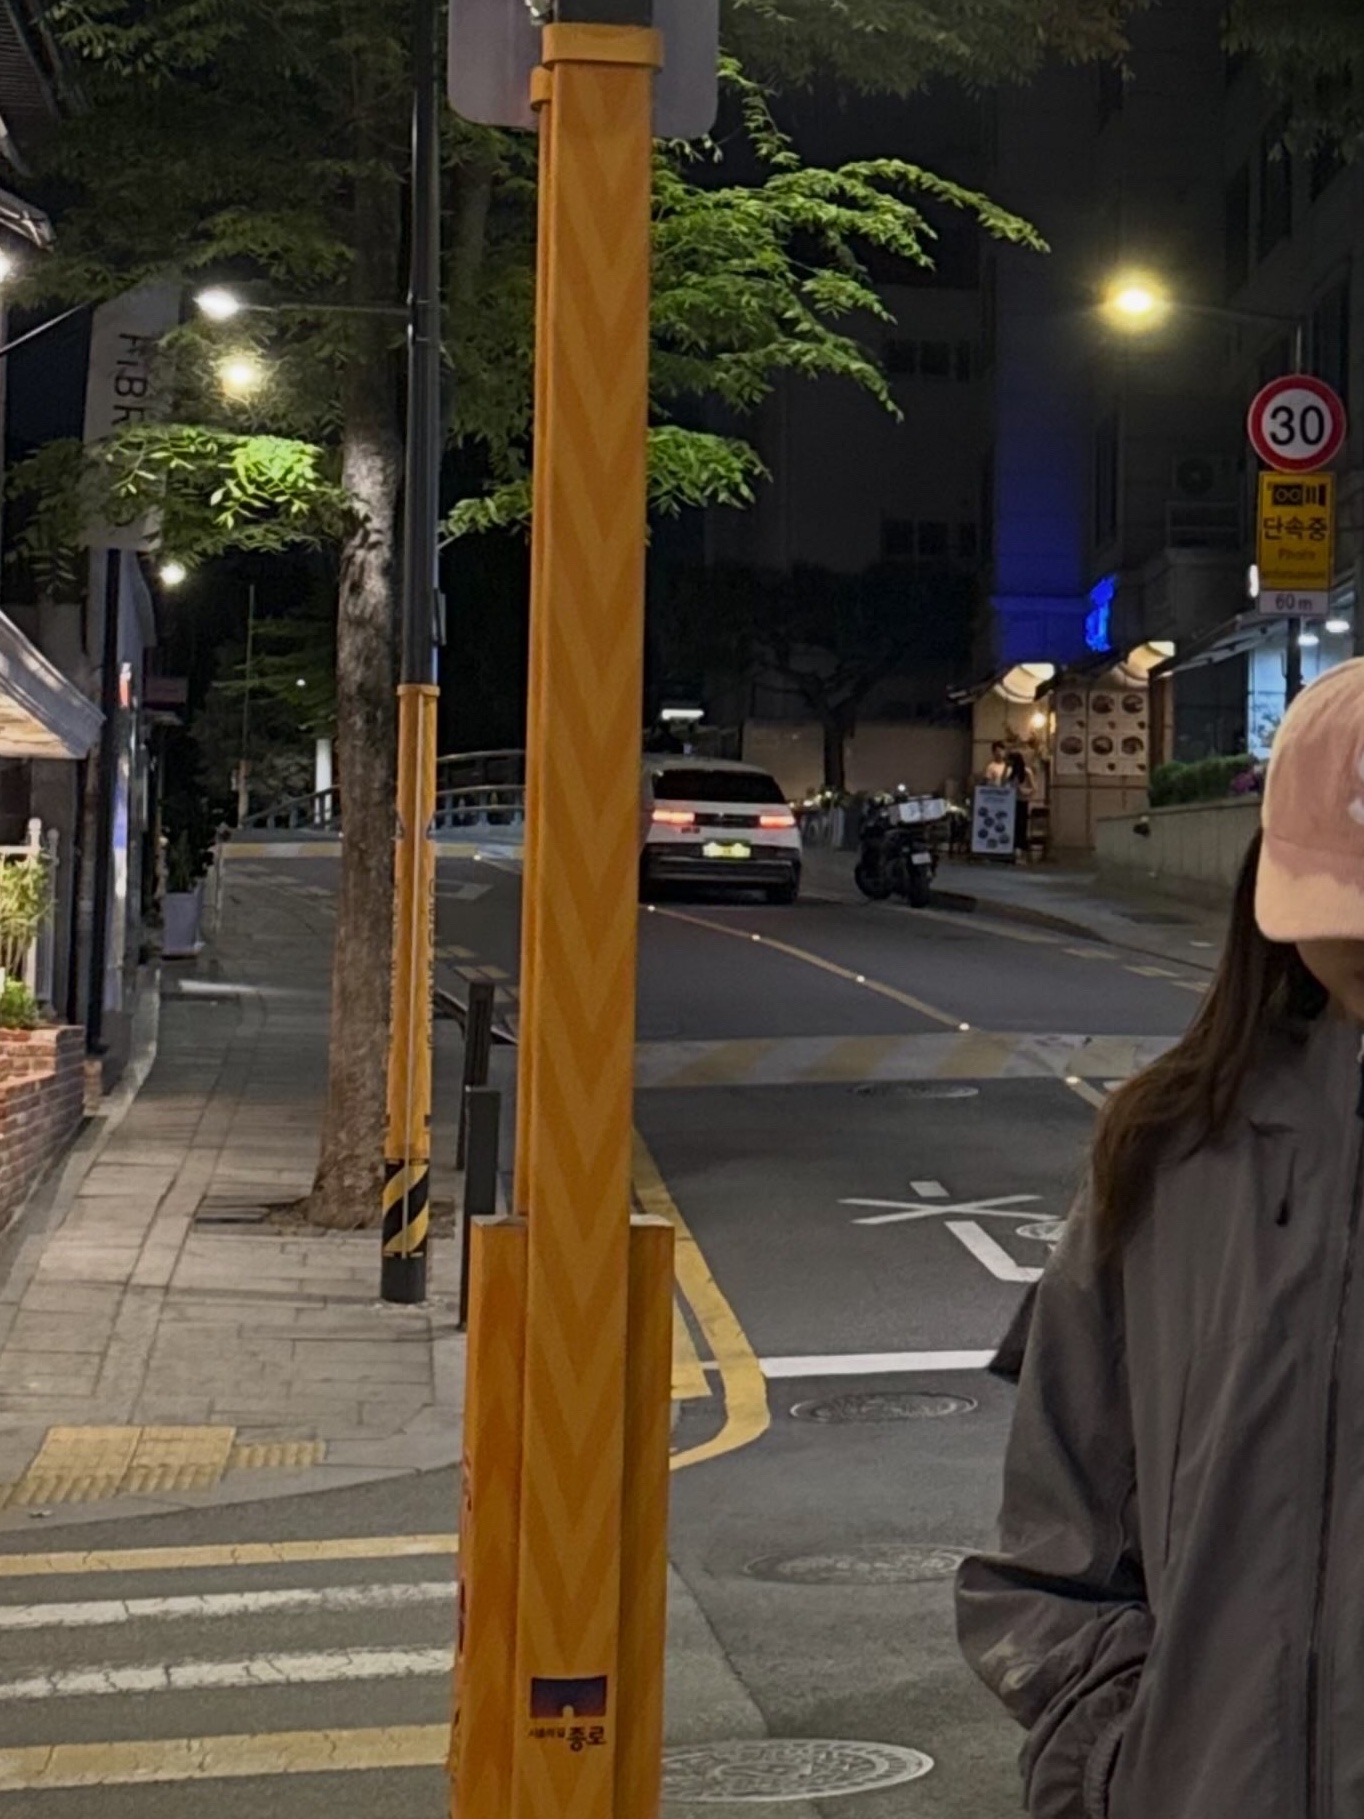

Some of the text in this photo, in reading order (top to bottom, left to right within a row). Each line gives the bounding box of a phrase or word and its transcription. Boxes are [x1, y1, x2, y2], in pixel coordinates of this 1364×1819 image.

[1269, 405, 1325, 446] 30
[1263, 515, 1327, 541] 단속중
[1274, 592, 1296, 611] 60
[566, 1725, 607, 1752] 종로
